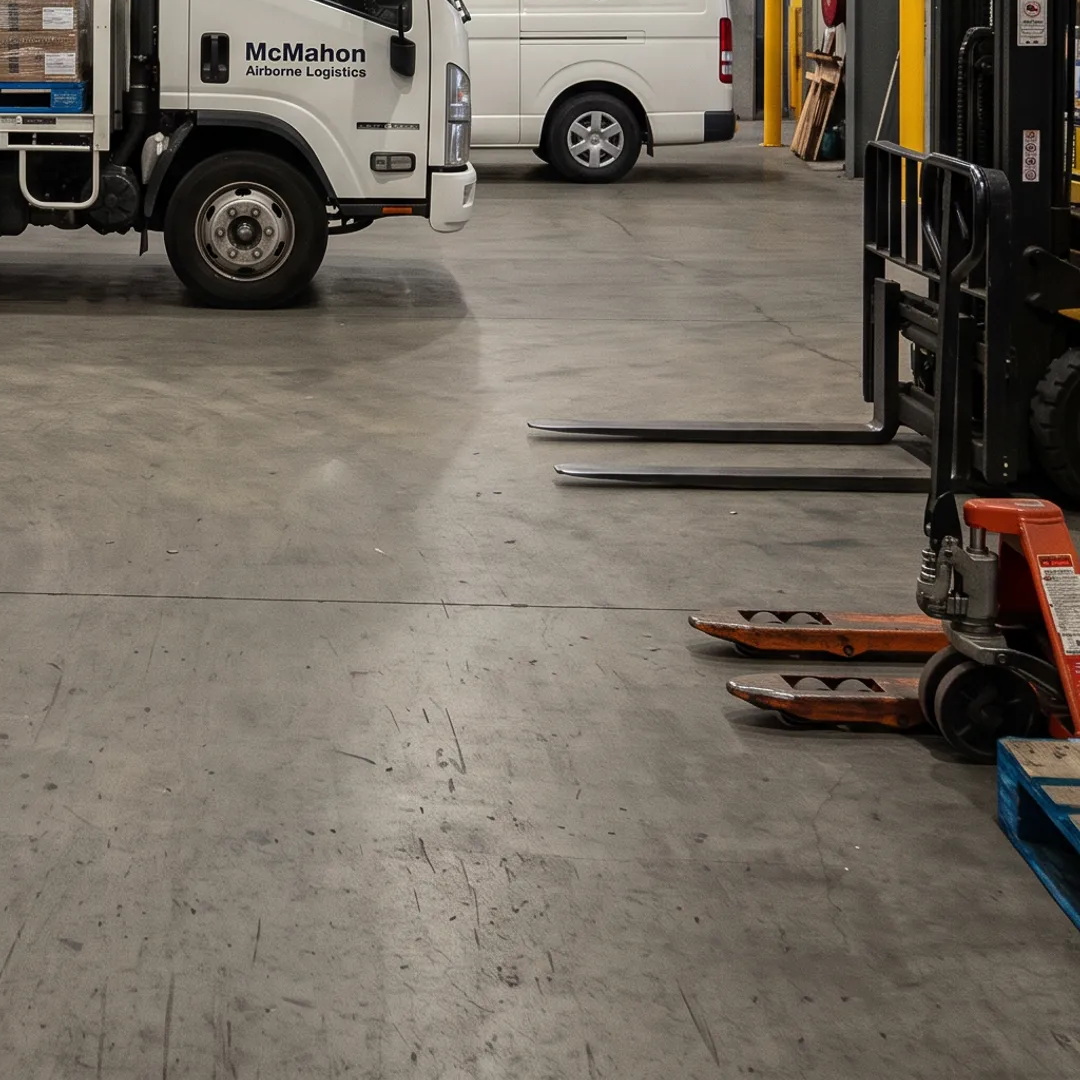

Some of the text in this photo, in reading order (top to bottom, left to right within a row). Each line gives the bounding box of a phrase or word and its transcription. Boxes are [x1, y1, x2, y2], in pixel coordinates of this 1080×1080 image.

[246, 42, 366, 63] McMahon
[246, 65, 367, 80] Airborne Logistics
